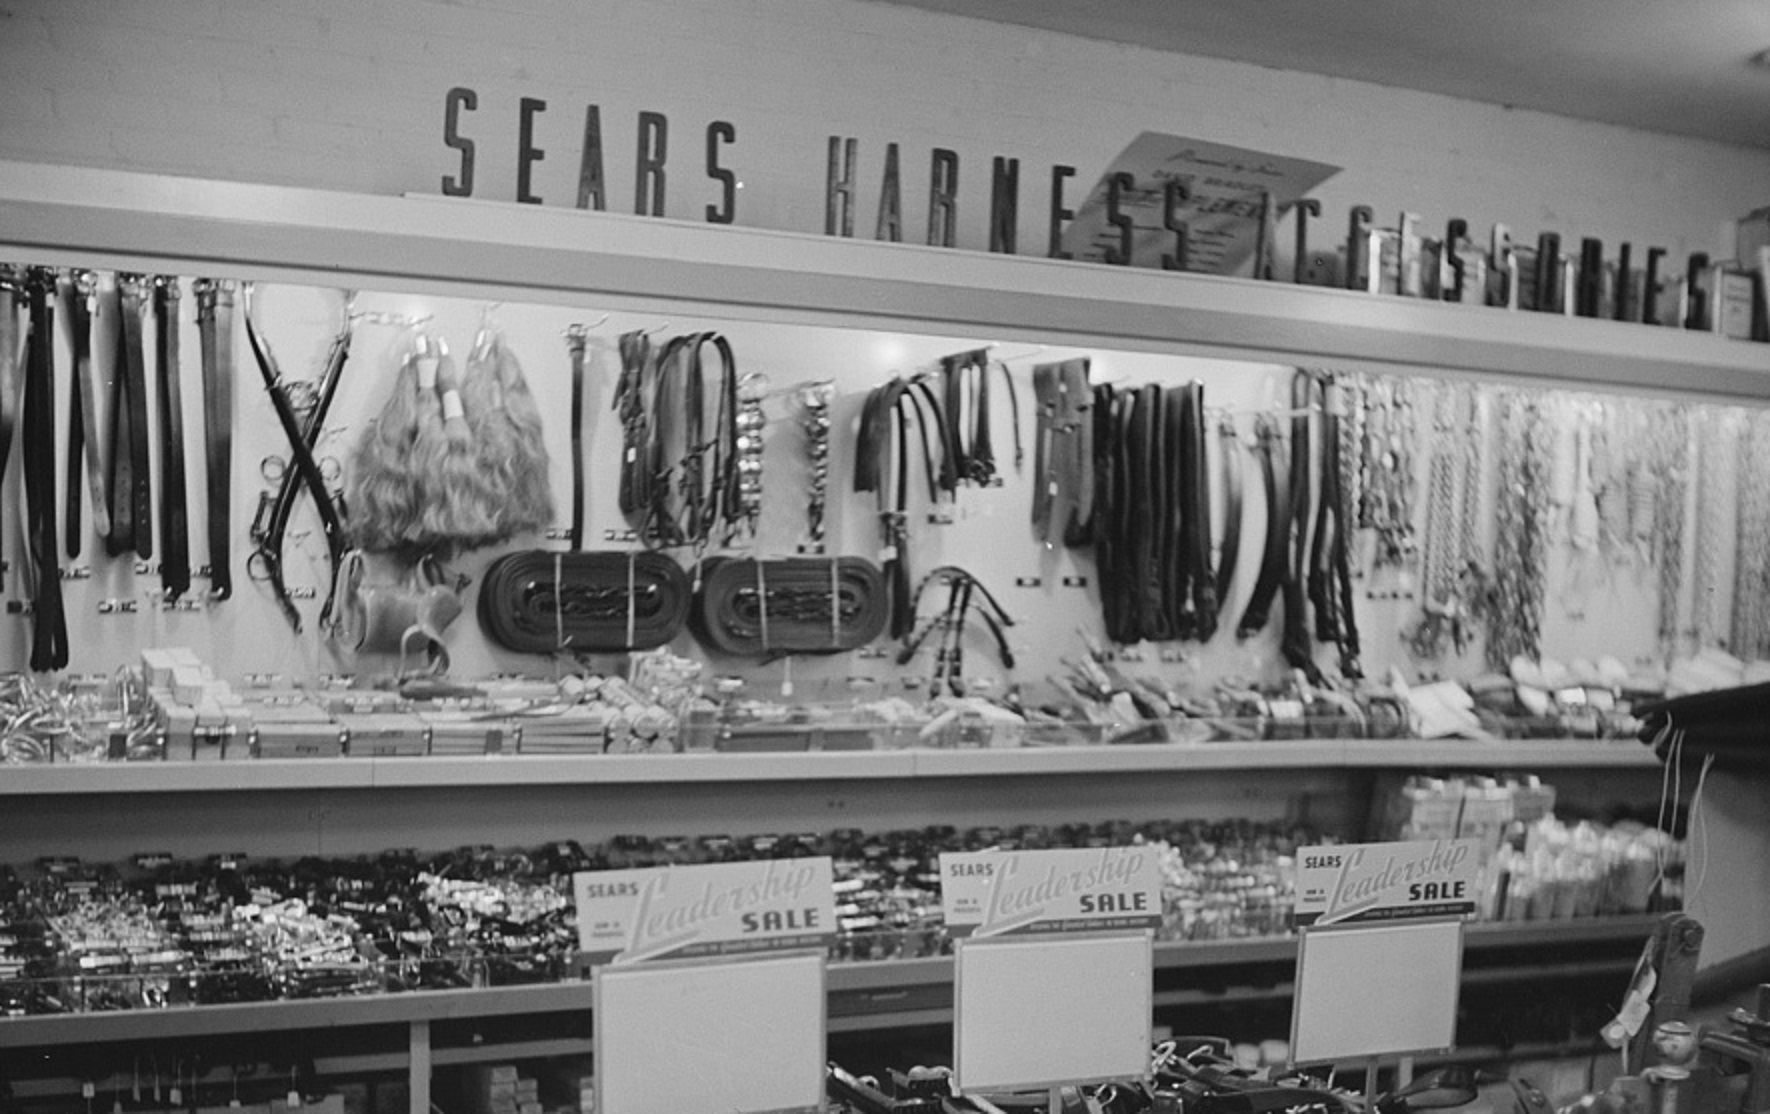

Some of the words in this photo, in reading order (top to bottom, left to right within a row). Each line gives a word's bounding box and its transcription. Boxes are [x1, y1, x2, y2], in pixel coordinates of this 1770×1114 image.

[442, 87, 735, 225] SEARS
[825, 135, 1190, 270] HARNESS
[951, 863, 993, 877] SEARS
[1304, 855, 1341, 869] SEARS
[587, 882, 639, 899] SEARS
[972, 848, 1143, 938] Leadership
[1314, 839, 1468, 926] Leadership
[1409, 881, 1466, 901] SALE
[612, 860, 814, 965] Leadership
[1080, 892, 1147, 913] SALE
[742, 907, 819, 933] SALE
